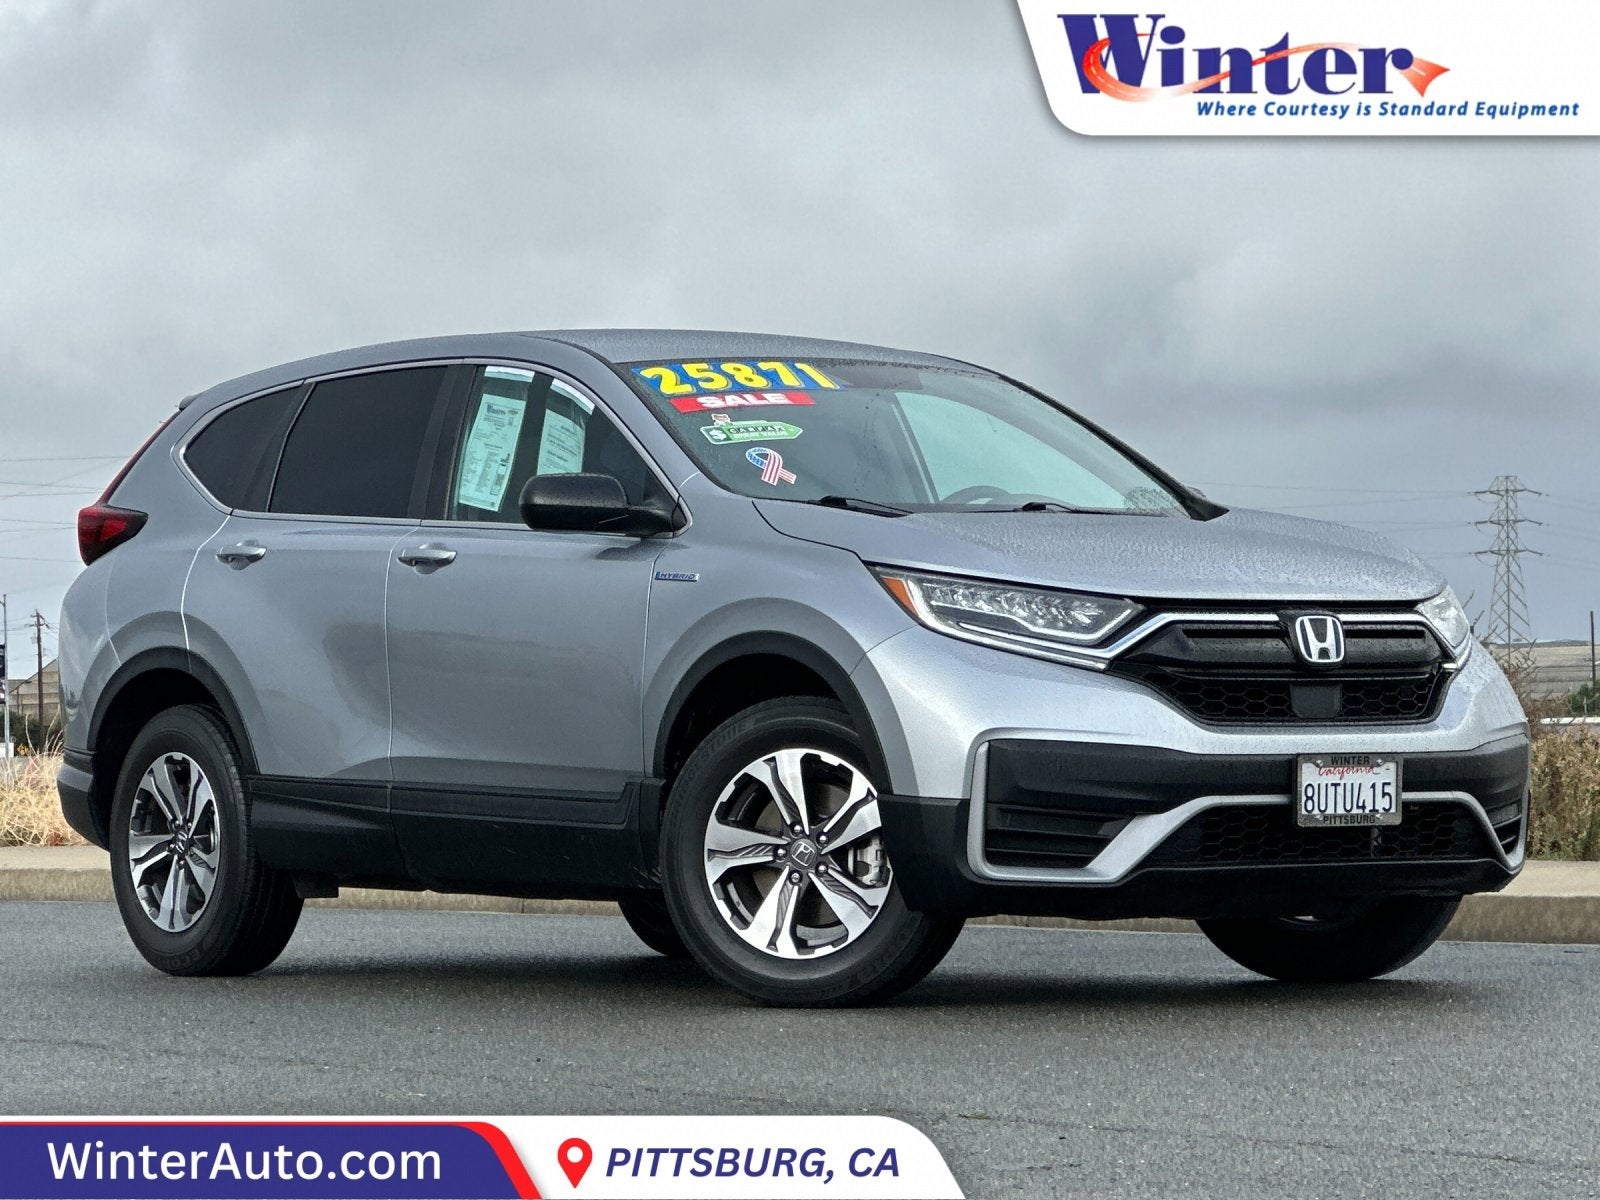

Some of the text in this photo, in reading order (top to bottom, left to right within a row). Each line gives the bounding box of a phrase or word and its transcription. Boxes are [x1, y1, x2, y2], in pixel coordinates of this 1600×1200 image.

[639, 360, 841, 396] 25871
[696, 392, 790, 409] SALE
[659, 572, 697, 580] HYBRID
[1330, 755, 1371, 766] WINTER
[1318, 764, 1381, 781] California
[1303, 782, 1393, 814] 8UTU415
[1322, 814, 1377, 825] PITTSBURG
